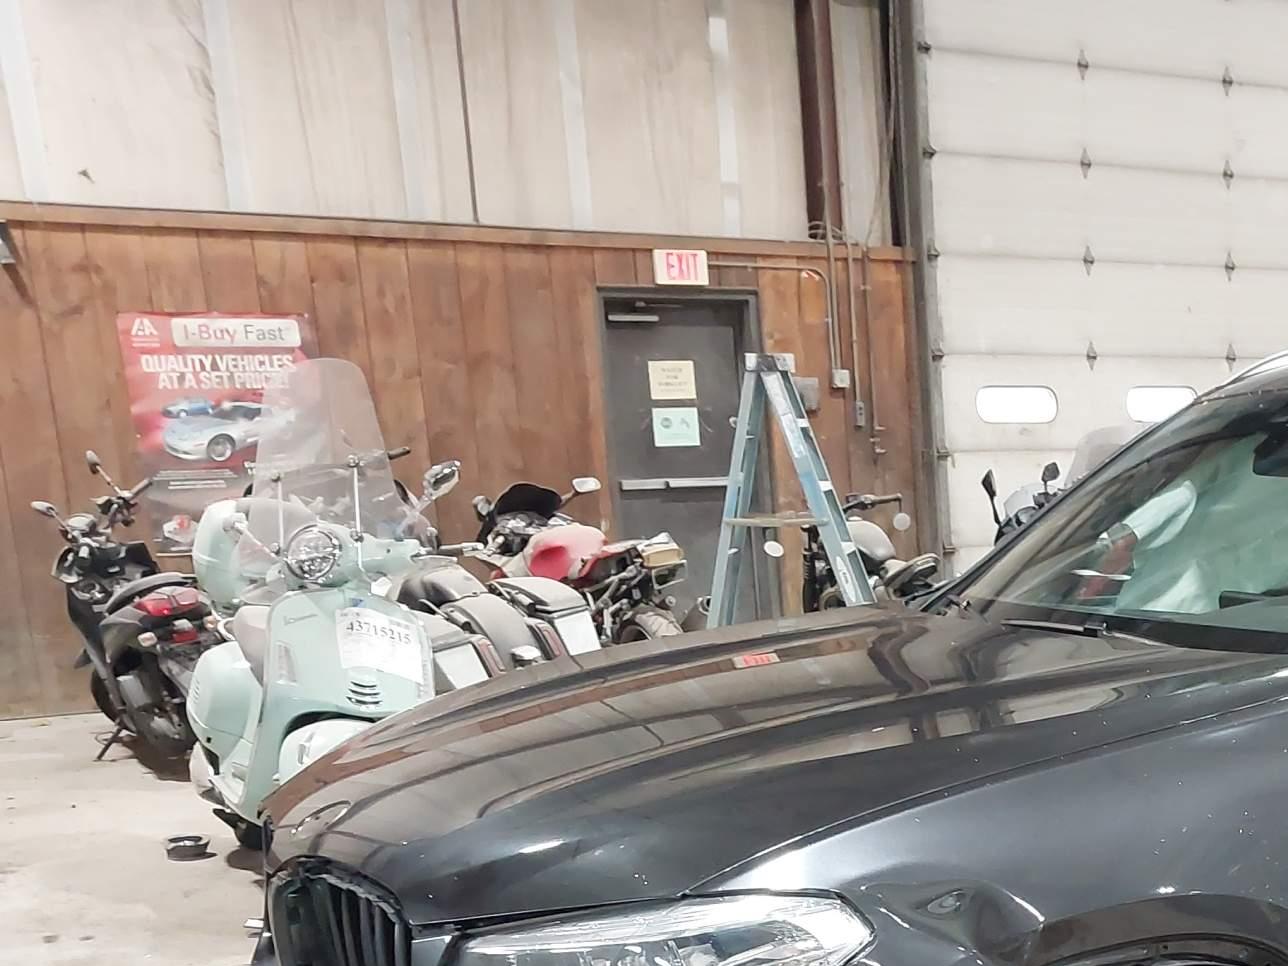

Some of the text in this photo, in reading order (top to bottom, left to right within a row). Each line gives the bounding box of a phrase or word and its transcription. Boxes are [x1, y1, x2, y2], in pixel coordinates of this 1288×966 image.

[665, 252, 699, 281] EXIT
[183, 324, 285, 344] I-Buy Fast
[140, 354, 297, 373] QUALITY VEHICLES
[158, 372, 181, 390] AT
[183, 372, 199, 389] A
[200, 371, 233, 389] SET
[346, 619, 412, 645] 43715215
